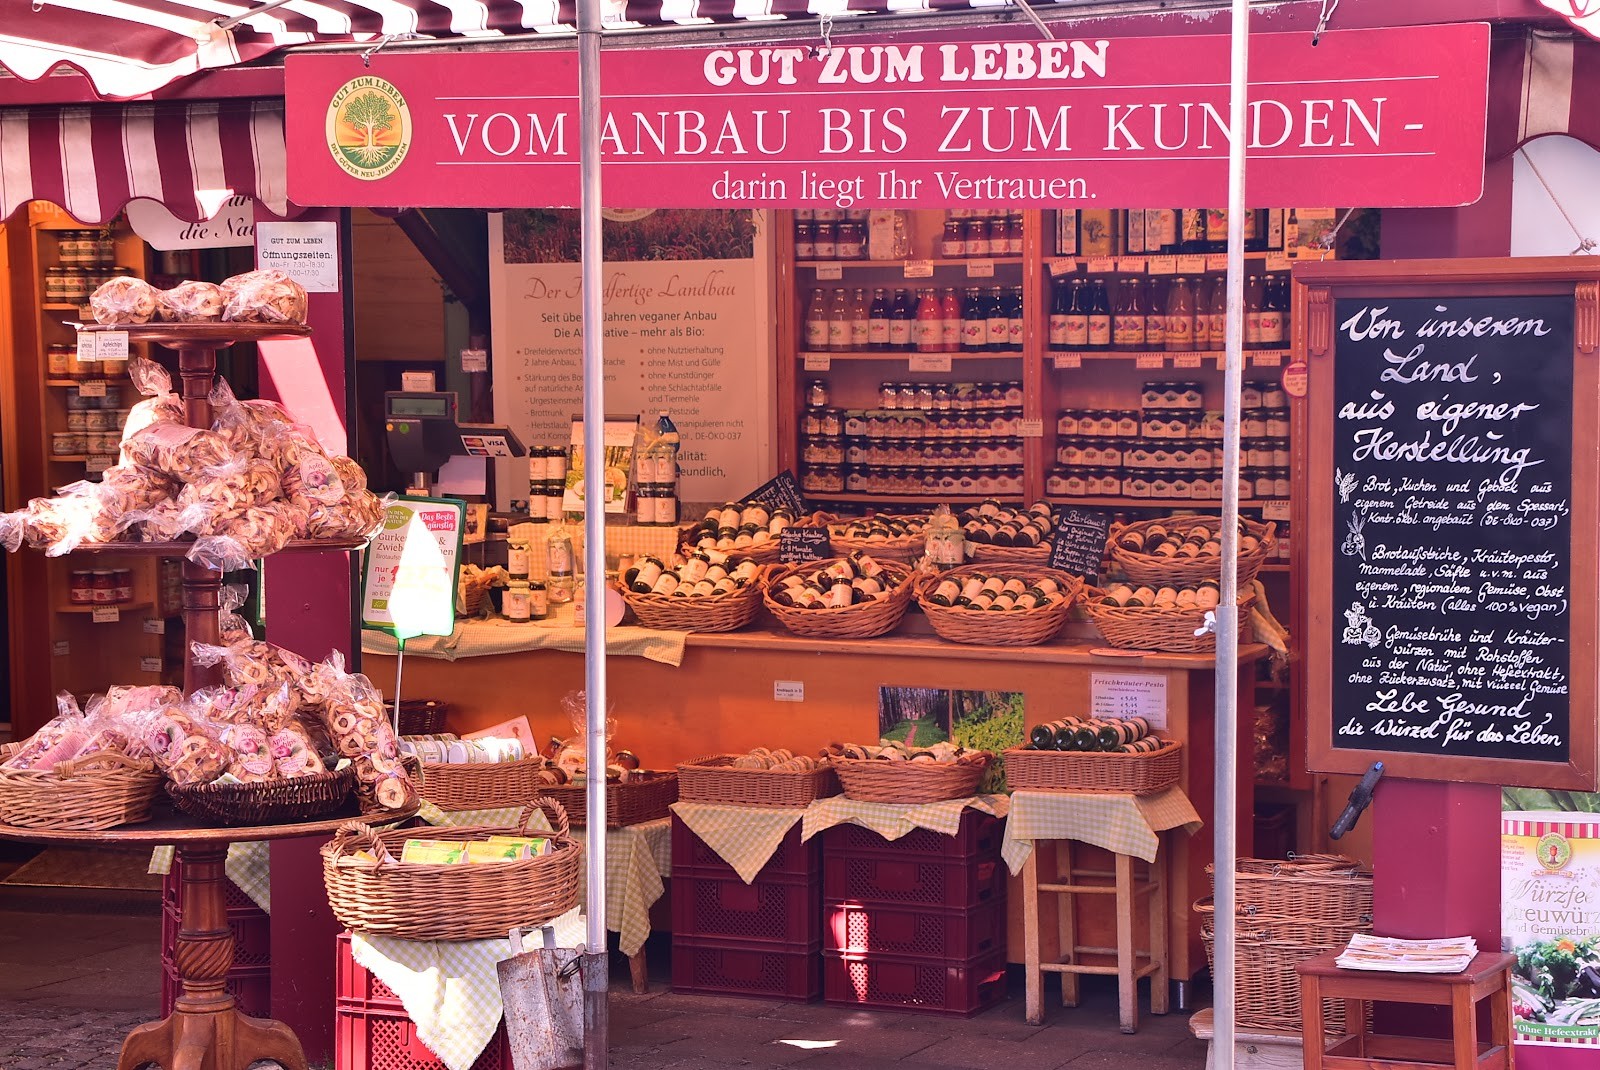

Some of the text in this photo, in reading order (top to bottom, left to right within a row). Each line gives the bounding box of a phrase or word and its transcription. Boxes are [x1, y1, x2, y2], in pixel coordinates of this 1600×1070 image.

[702, 39, 1110, 88] GUT ZUM LEBEN
[332, 77, 405, 109] GUT ZUM LEBEN
[443, 111, 568, 157] VOM
[600, 107, 790, 156] ANBAU
[818, 106, 908, 155] BIS
[937, 103, 1072, 153] ZUM
[1102, 98, 1388, 152] KUNDEN
[330, 142, 339, 157] DIE
[711, 169, 1098, 207] darin liegt Ihr Vertrauen.
[179, 223, 208, 240] die
[262, 248, 333, 260] Öffnungszeiten:
[524, 276, 562, 300] Der
[658, 270, 736, 298] Landbau
[541, 312, 560, 323] Seit
[563, 312, 583, 323] übe
[639, 312, 681, 324] veganer
[683, 311, 717, 321] Anbau
[1340, 305, 1551, 341] Von unserem
[554, 327, 571, 339] Die
[640, 327, 667, 338] mehr
[669, 327, 683, 337] als
[685, 326, 705, 337] Bio:
[667, 346, 724, 355] Nutztierhaltung
[701, 358, 721, 366] Gülle
[668, 371, 715, 381] Kunstdünger
[668, 383, 722, 392] Schlachtabfälle
[1416, 394, 1540, 436] eigener
[1353, 427, 1545, 485] Herstellung
[1446, 478, 1470, 492] und
[1354, 499, 1395, 515] eigenem
[1404, 496, 1449, 516] Getreide
[1486, 500, 1510, 512] dem
[1517, 499, 1570, 516] Spessart,
[421, 513, 434, 521] Das
[427, 522, 454, 530] günstig
[1422, 513, 1473, 532] angebaut
[378, 533, 407, 542] Gurke
[1471, 548, 1559, 569] Kräuterpesto,
[377, 575, 386, 583] je
[1434, 564, 1472, 583] Säfte
[1523, 568, 1548, 580] aus
[1410, 581, 1472, 602] regionalem
[1477, 582, 1531, 603] Gemüse,
[1535, 585, 1565, 598] Obst
[1382, 595, 1437, 611] Kräutern
[1441, 597, 1477, 615] (alles
[1385, 625, 1462, 649] Gemüsebrühe
[1469, 629, 1494, 644] und
[1393, 643, 1544, 669] würzen mit Rohstoffen
[1388, 657, 1409, 670] der
[1457, 663, 1486, 677] ohne
[1348, 673, 1373, 684] ohne
[1462, 677, 1483, 690] mit
[1530, 680, 1568, 702] Gemüse
[1365, 689, 1430, 713] Lebe
[1338, 717, 1562, 747] die Wurzel für das Leben
[1530, 924, 1600, 936] Gemüsebrüh
[1518, 1024, 1597, 1037] Ohne Hefeextrakt
